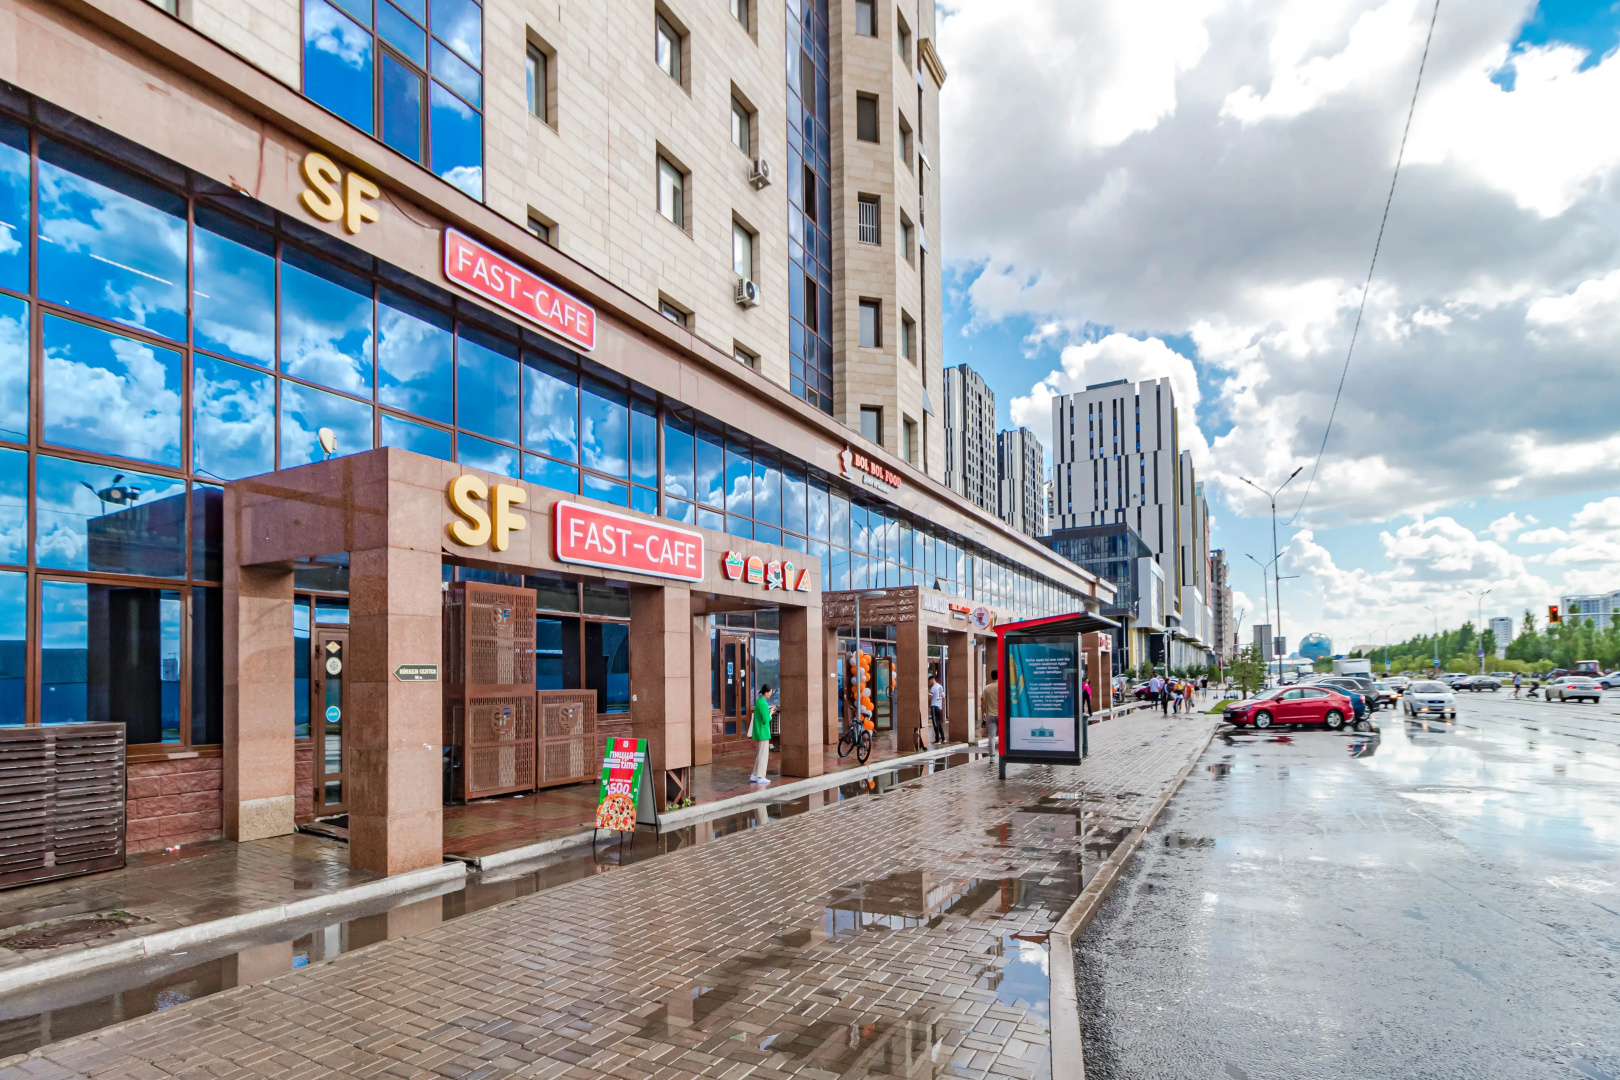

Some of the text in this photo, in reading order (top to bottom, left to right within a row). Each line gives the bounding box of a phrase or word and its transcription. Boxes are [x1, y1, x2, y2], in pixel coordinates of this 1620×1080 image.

[299, 152, 380, 235] SF
[458, 245, 588, 337] FAST-CAFE
[854, 453, 869, 471] BOL
[869, 461, 883, 479] BOL
[884, 469, 901, 488] FOOD
[449, 475, 527, 551] SF
[569, 517, 697, 570] FAST-CAFE
[493, 607, 512, 624] SF
[620, 759, 638, 770] time
[605, 782, 630, 796] 1500
